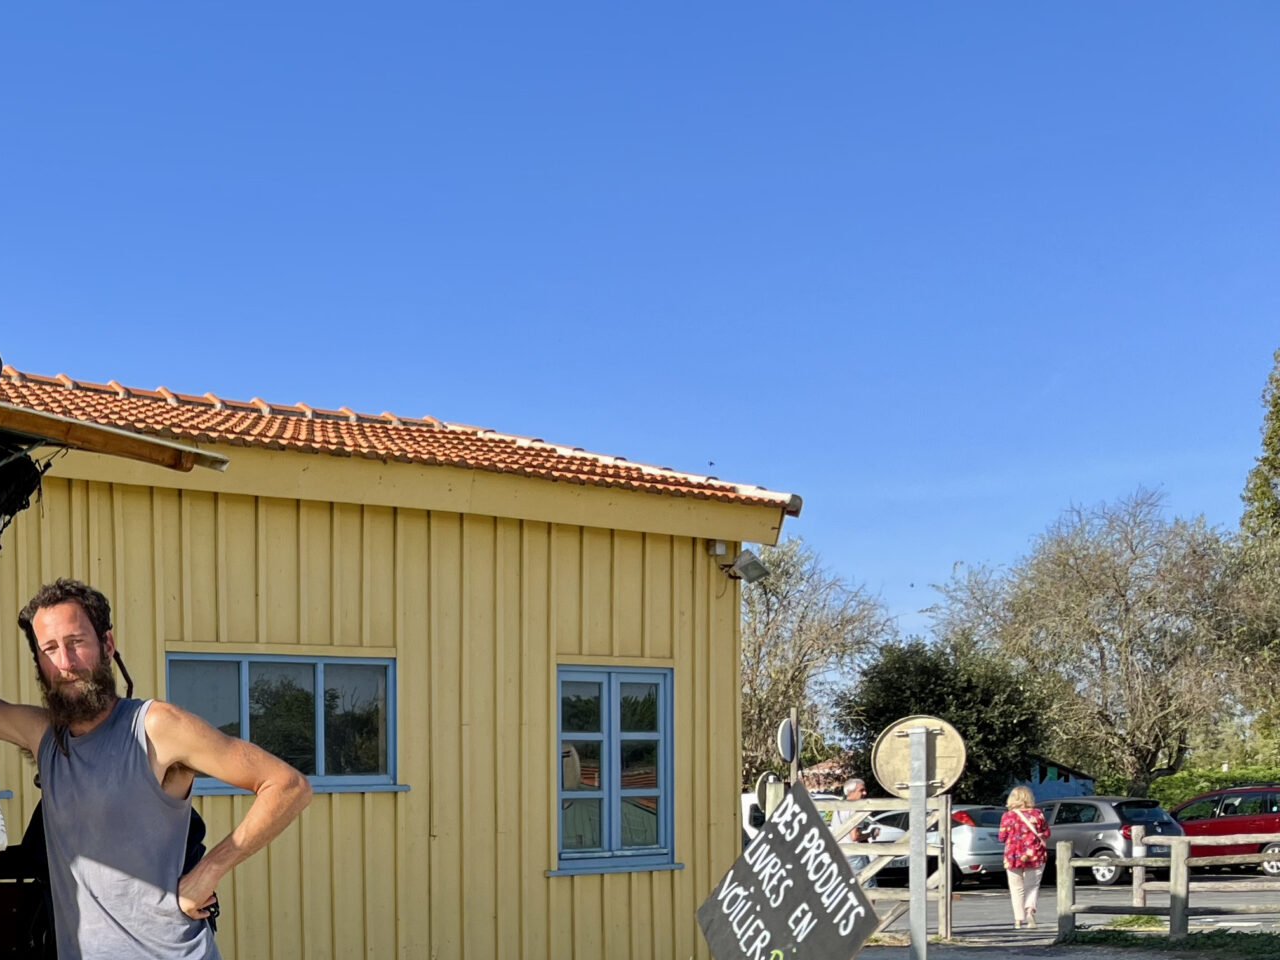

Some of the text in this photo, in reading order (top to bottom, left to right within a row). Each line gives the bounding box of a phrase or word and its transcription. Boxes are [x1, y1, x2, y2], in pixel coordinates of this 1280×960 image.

[743, 831, 818, 943] LIVRÉS EN
[770, 793, 866, 936] DES PRODUITS
